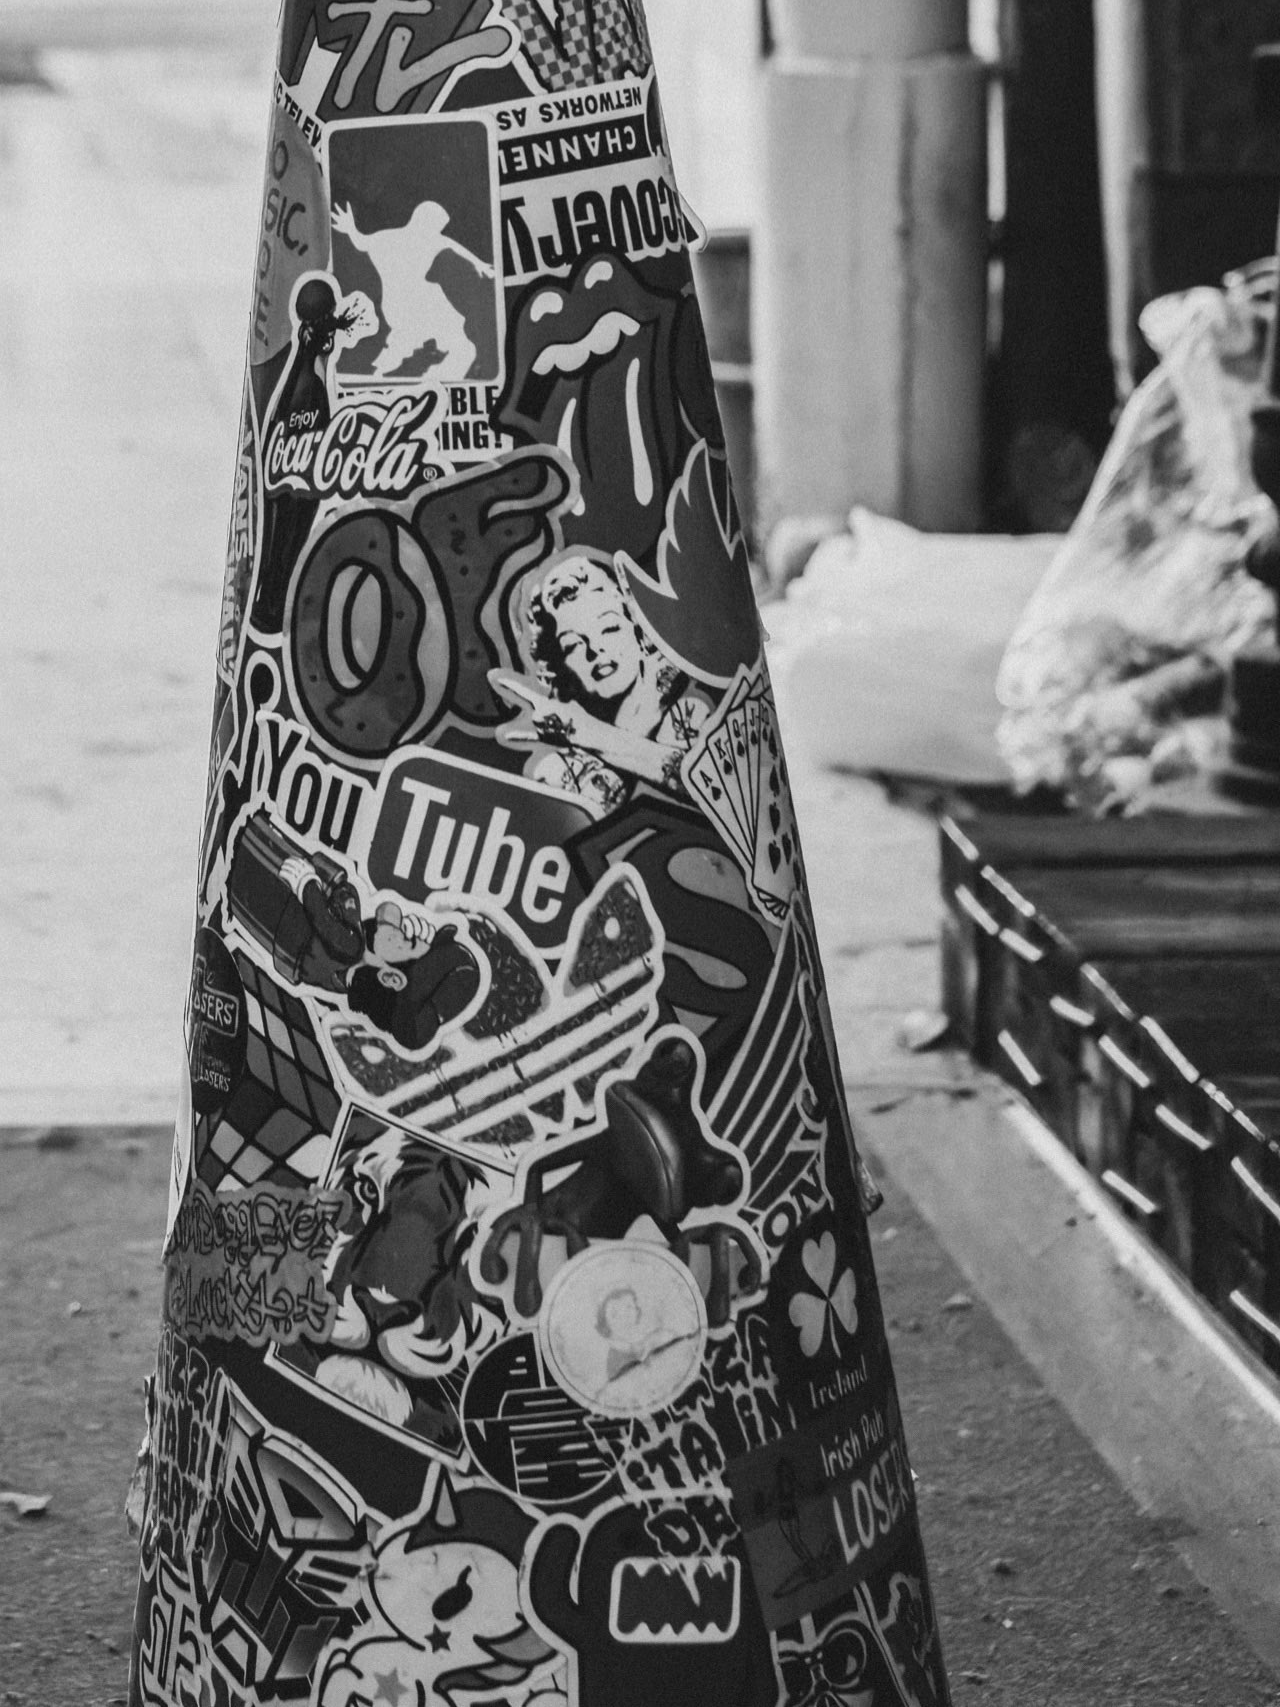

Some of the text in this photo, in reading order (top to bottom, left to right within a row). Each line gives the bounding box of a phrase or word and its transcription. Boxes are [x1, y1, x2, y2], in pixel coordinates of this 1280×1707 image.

[495, 86, 642, 132] NETWORKS AS
[289, 409, 319, 429] Enjoy
[446, 385, 499, 415] BLE
[439, 420, 503, 451] ING!
[265, 719, 572, 925] You Tube
[809, 1353, 870, 1409] Ireland
[820, 1405, 886, 1478] Irish Pub
